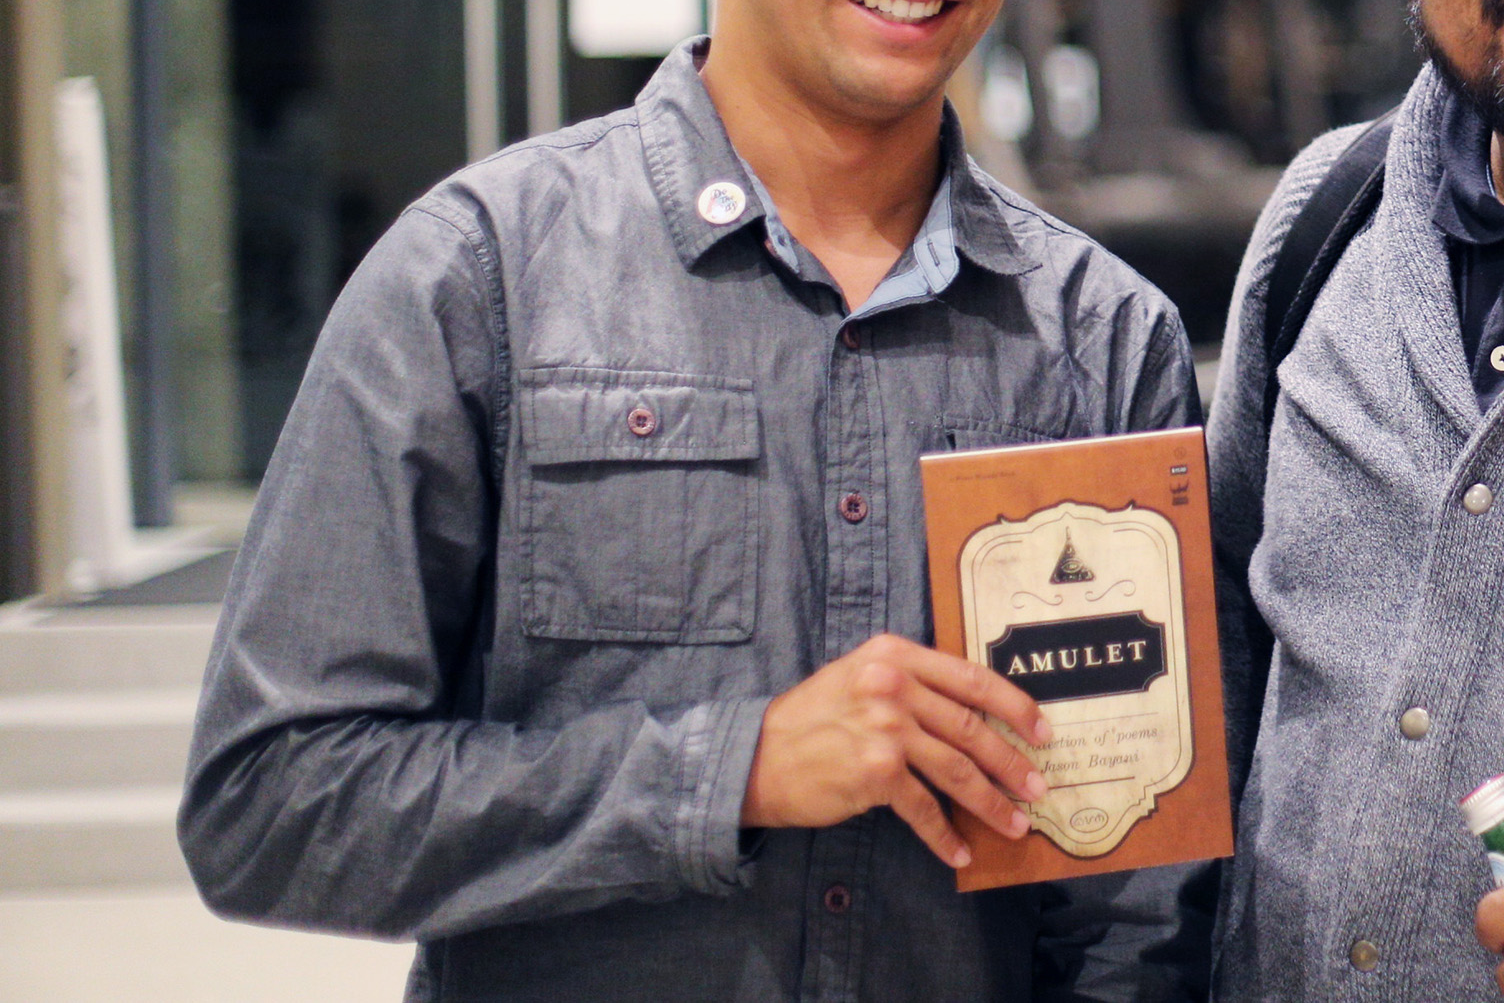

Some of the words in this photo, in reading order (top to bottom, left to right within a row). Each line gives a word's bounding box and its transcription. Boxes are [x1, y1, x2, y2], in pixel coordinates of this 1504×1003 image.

[1007, 640, 1147, 675] AMULET
[1094, 729, 1110, 747] of
[1116, 727, 1158, 744] poems
[1040, 759, 1080, 774] Jason
[1088, 750, 1140, 769] Bayani
